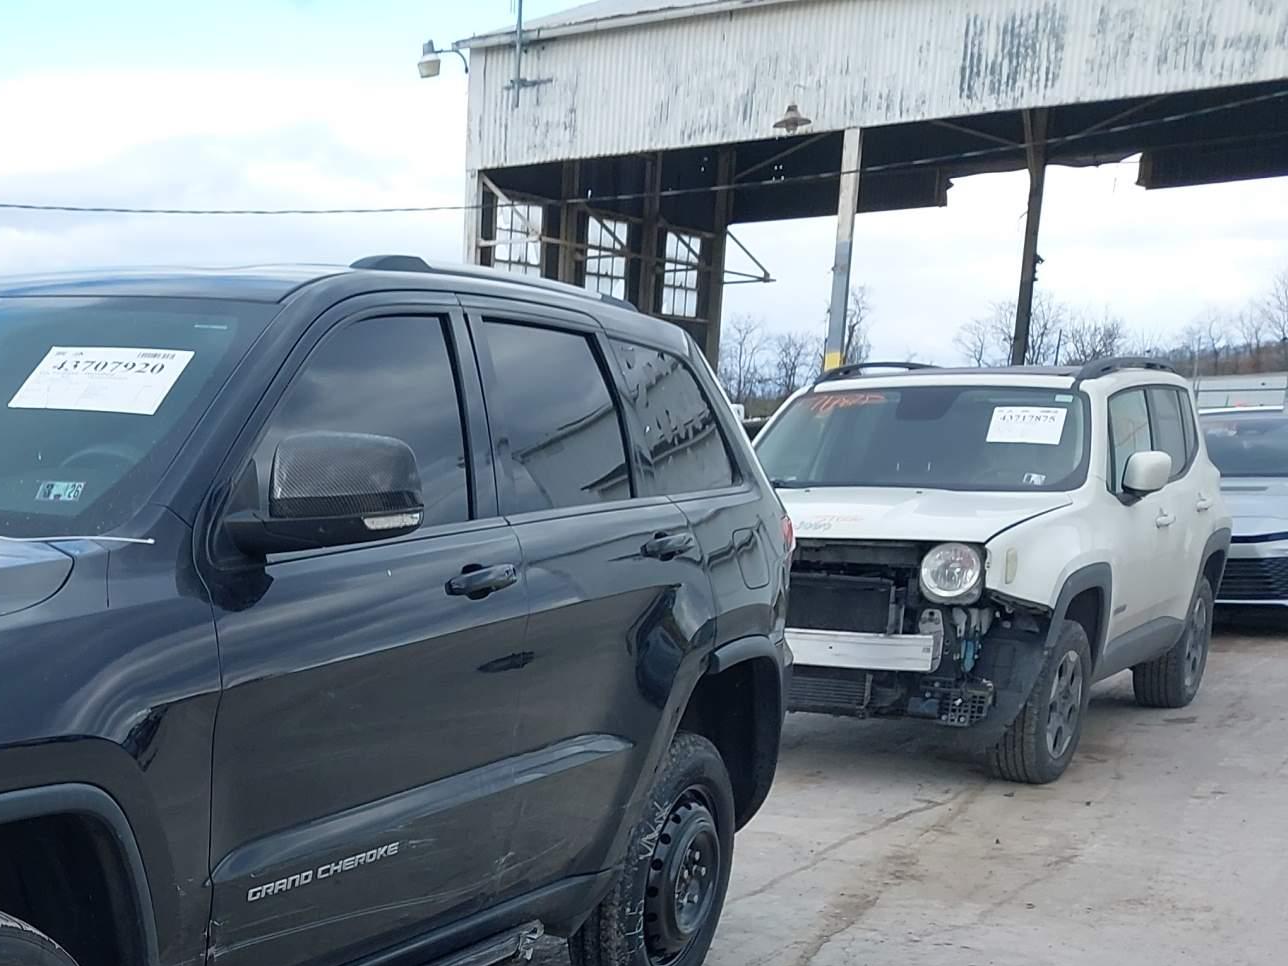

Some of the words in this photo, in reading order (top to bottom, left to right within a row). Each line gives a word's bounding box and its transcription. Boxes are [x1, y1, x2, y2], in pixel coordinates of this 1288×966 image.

[52, 359, 166, 375] 43707920
[247, 870, 313, 902] GRAND
[316, 841, 401, 880] CHEROKE
